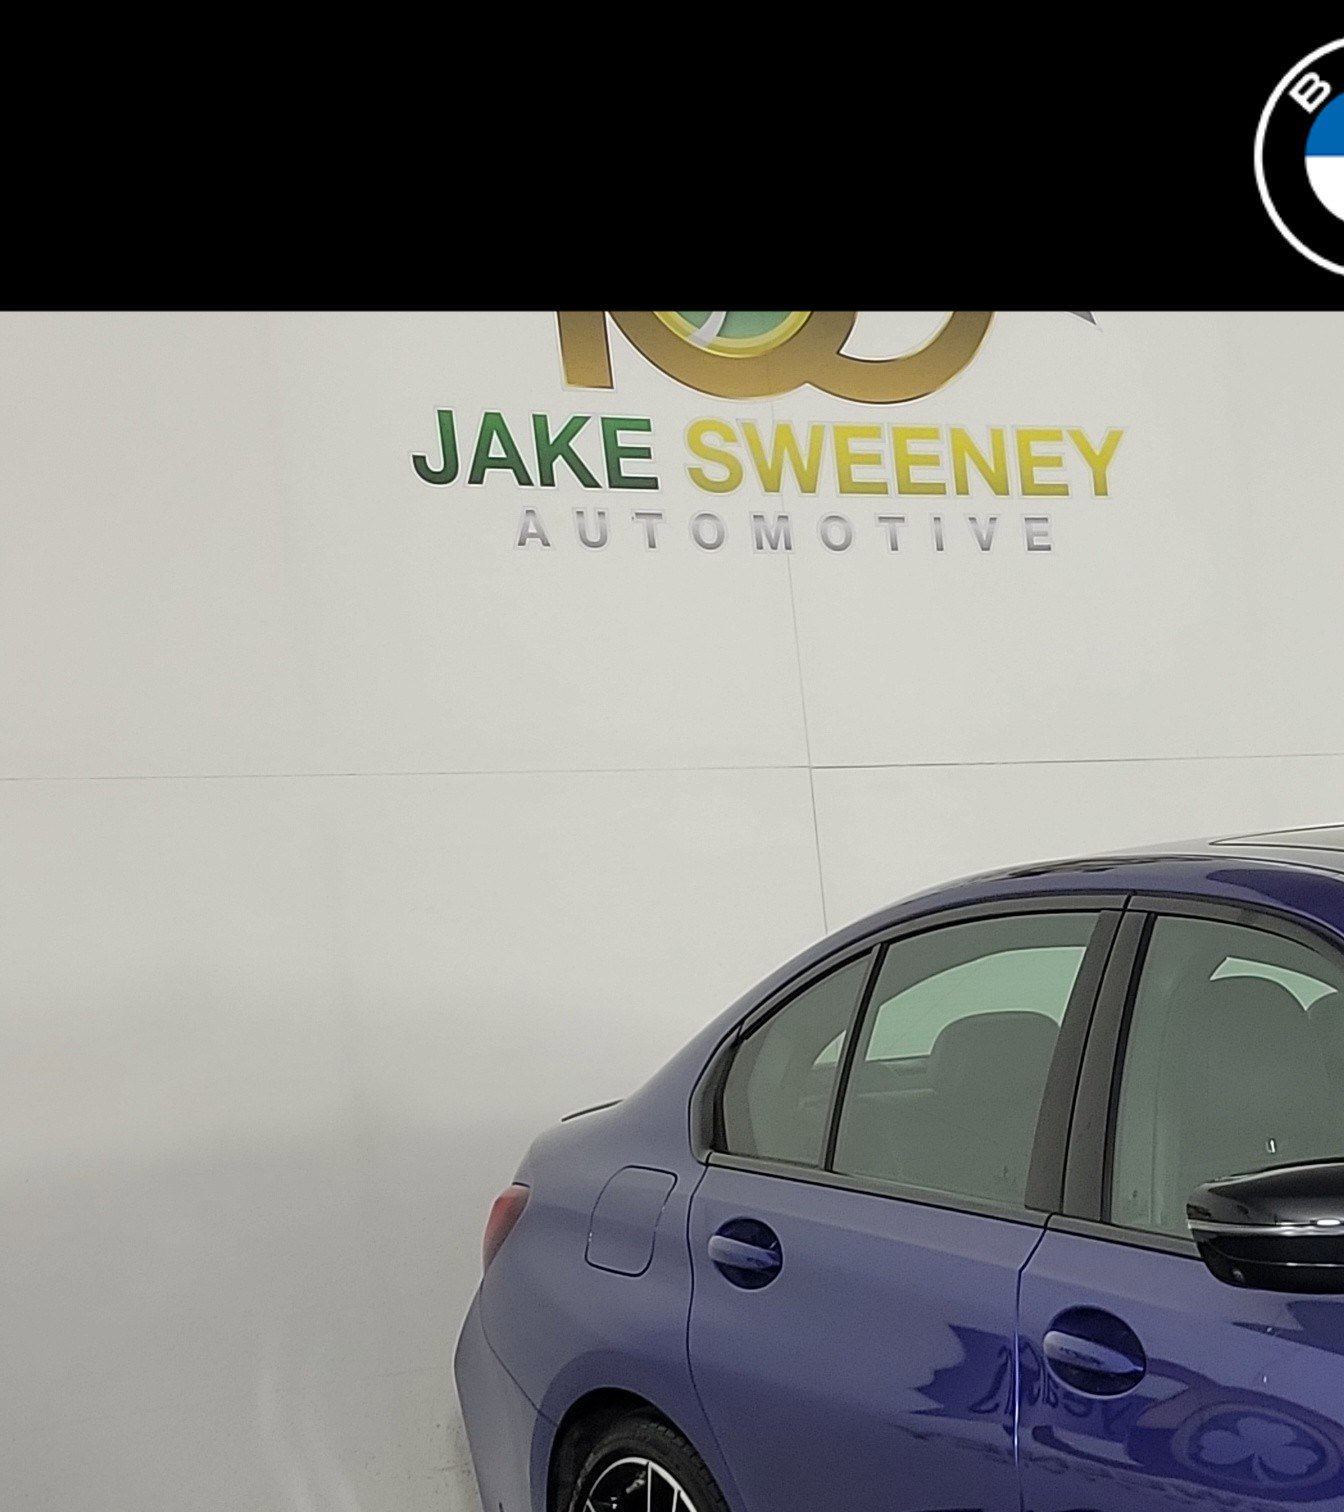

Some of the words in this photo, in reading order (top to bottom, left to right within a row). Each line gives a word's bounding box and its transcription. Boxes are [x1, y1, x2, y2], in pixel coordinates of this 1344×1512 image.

[412, 410, 660, 488] JAKE
[686, 419, 1125, 497] SWEENEY
[516, 509, 1054, 552] AUTOMOTIVE
